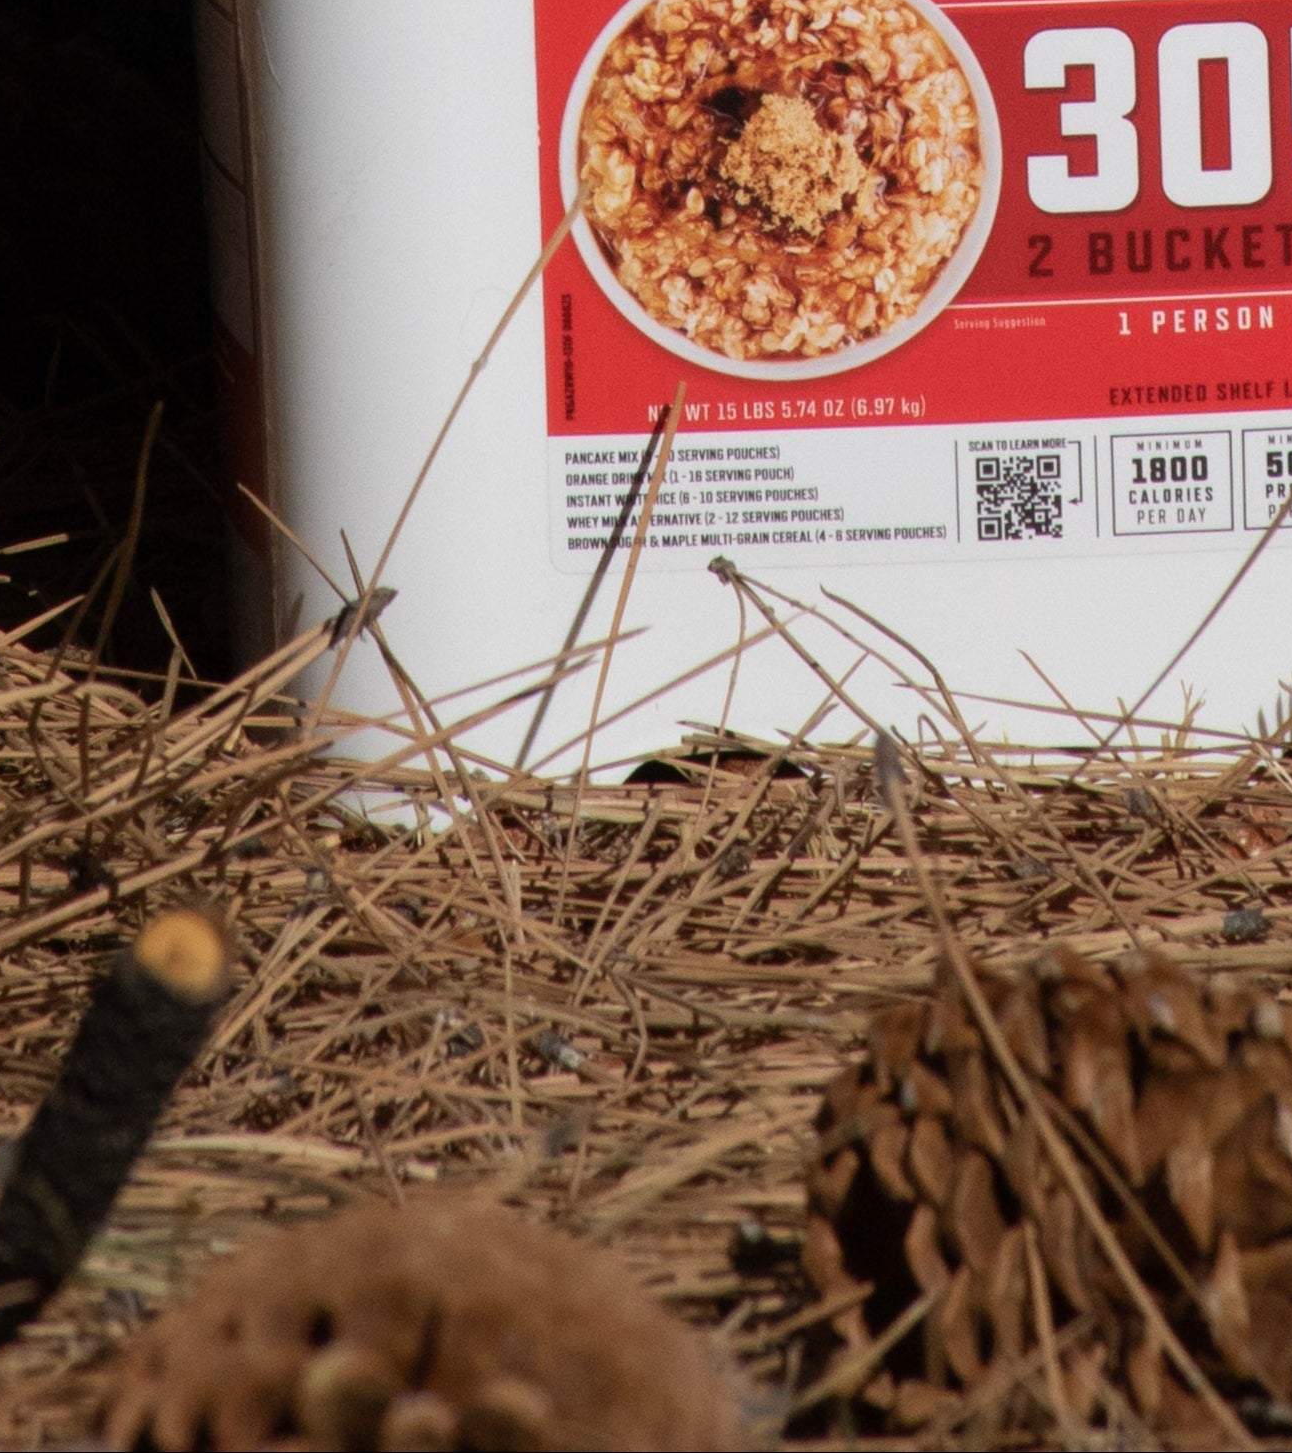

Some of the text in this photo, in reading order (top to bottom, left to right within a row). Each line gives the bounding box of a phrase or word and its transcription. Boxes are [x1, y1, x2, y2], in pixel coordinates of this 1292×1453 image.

[1024, 22, 1272, 213] 30
[1028, 234, 1053, 278] 2
[1119, 312, 1131, 335] 1
[1152, 306, 1273, 333] PERSON
[1109, 384, 1207, 406] EXTENDED
[1217, 381, 1273, 401] SHELF
[685, 404, 709, 421] WT
[718, 403, 737, 420] 15
[744, 401, 774, 419] LBS
[781, 400, 816, 418] 5.74
[824, 399, 844, 417] OZ
[852, 397, 894, 418] (6.97
[901, 396, 925, 417] kg)
[969, 438, 1066, 452] SCAN TO LEARN MORE
[1137, 439, 1202, 451] MINIMUM
[565, 451, 638, 464] PANCAKE MIX
[1132, 455, 1208, 484] 1800
[566, 473, 608, 486] ORANGE
[567, 494, 611, 507] INSTANT
[1129, 487, 1213, 505] CALORIES
[567, 516, 598, 529] WHEY
[1137, 508, 1205, 525] PER DAY
[662, 534, 697, 547] MAPLE
[772, 531, 812, 544] CEREAL
